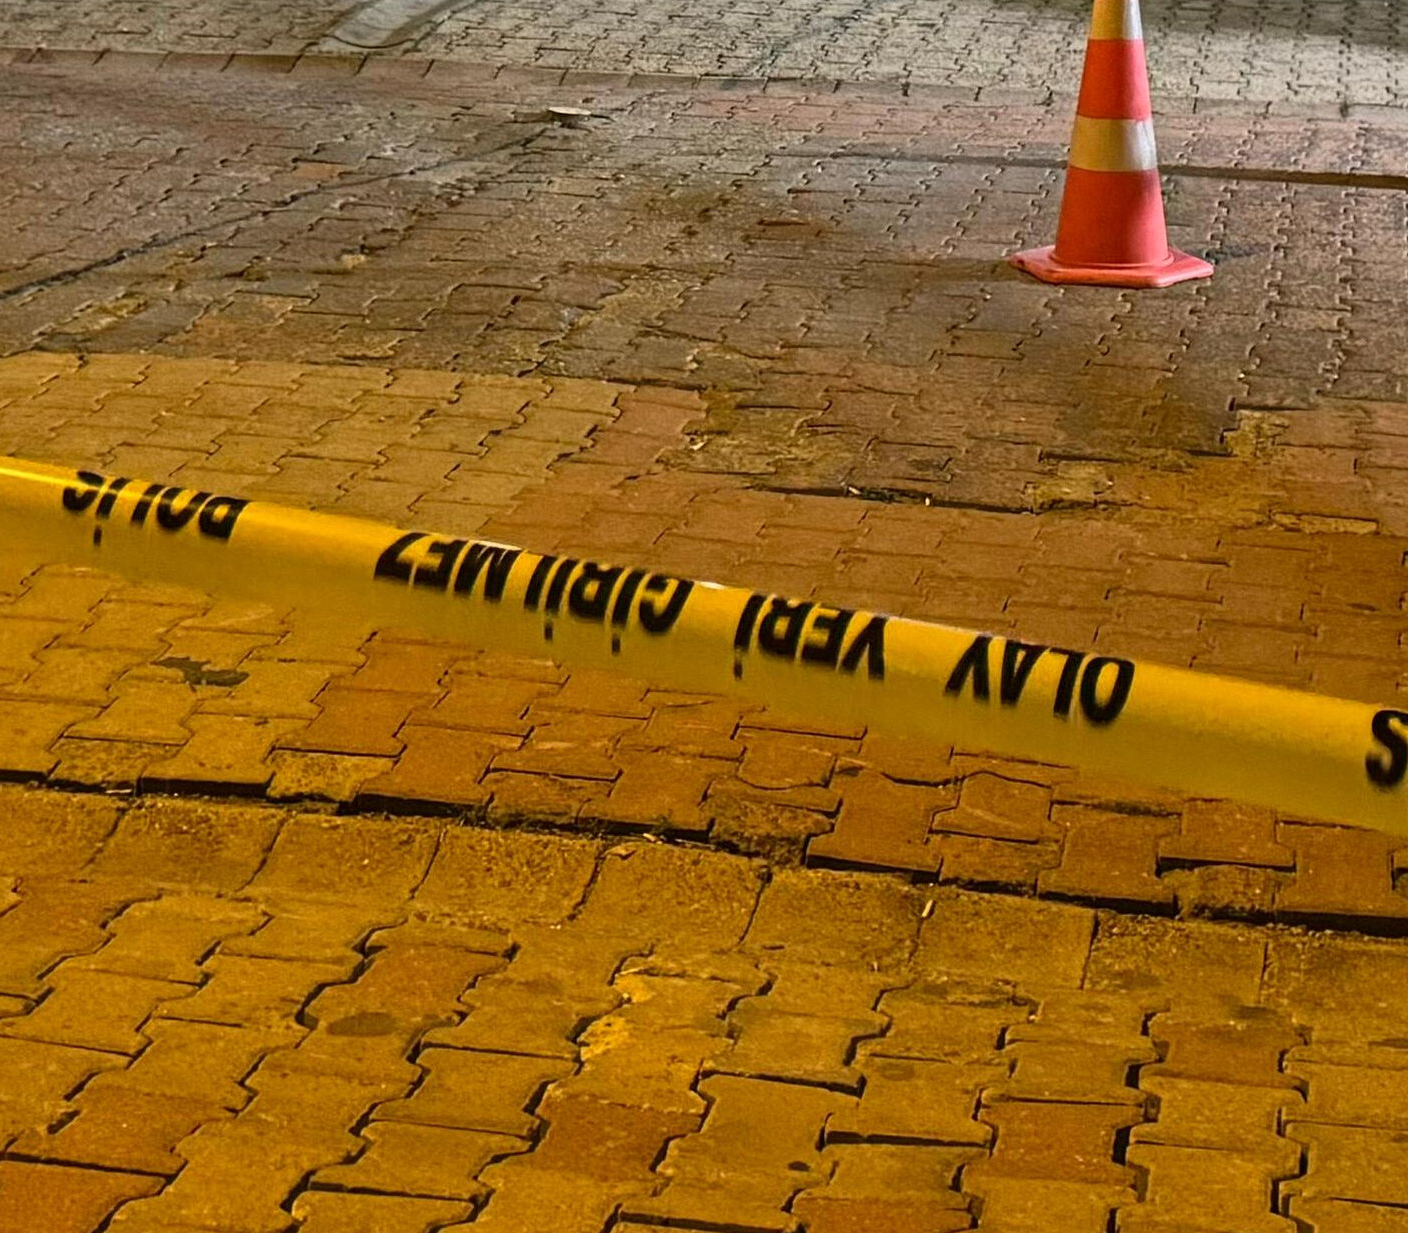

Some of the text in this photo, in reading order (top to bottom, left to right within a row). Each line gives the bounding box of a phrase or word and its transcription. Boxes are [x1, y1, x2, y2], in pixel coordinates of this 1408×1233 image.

[374, 531, 694, 655] GİRİLMEZ
[732, 592, 890, 680] YERİ
[944, 634, 1135, 726] OLAY
